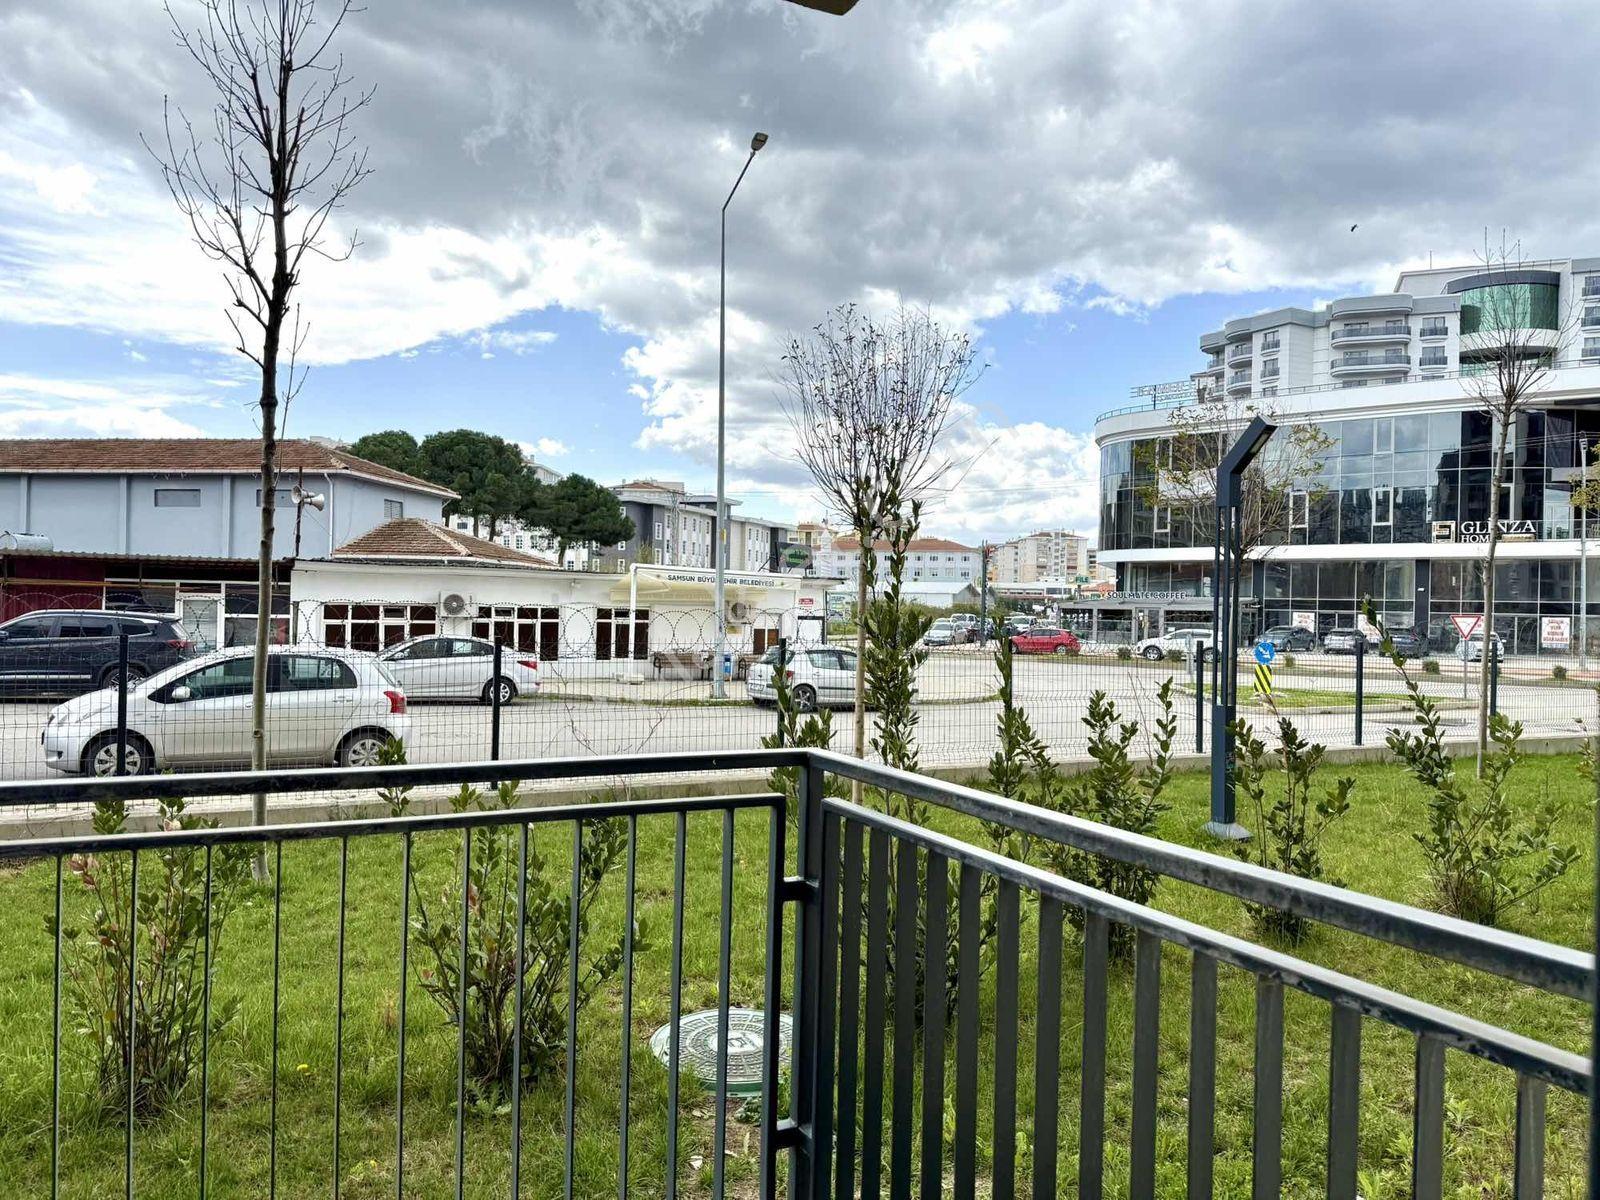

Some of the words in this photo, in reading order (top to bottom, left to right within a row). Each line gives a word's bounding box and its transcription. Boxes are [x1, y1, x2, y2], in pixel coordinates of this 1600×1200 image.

[1461, 534, 1492, 543] HOM
[667, 574, 696, 582] SAMSUN
[697, 576, 738, 584] BÜYÜEHİR
[739, 578, 775, 587] BELEDİYESİ
[1107, 591, 1151, 599] SOULMATE
[1153, 591, 1186, 599] COFFEE
